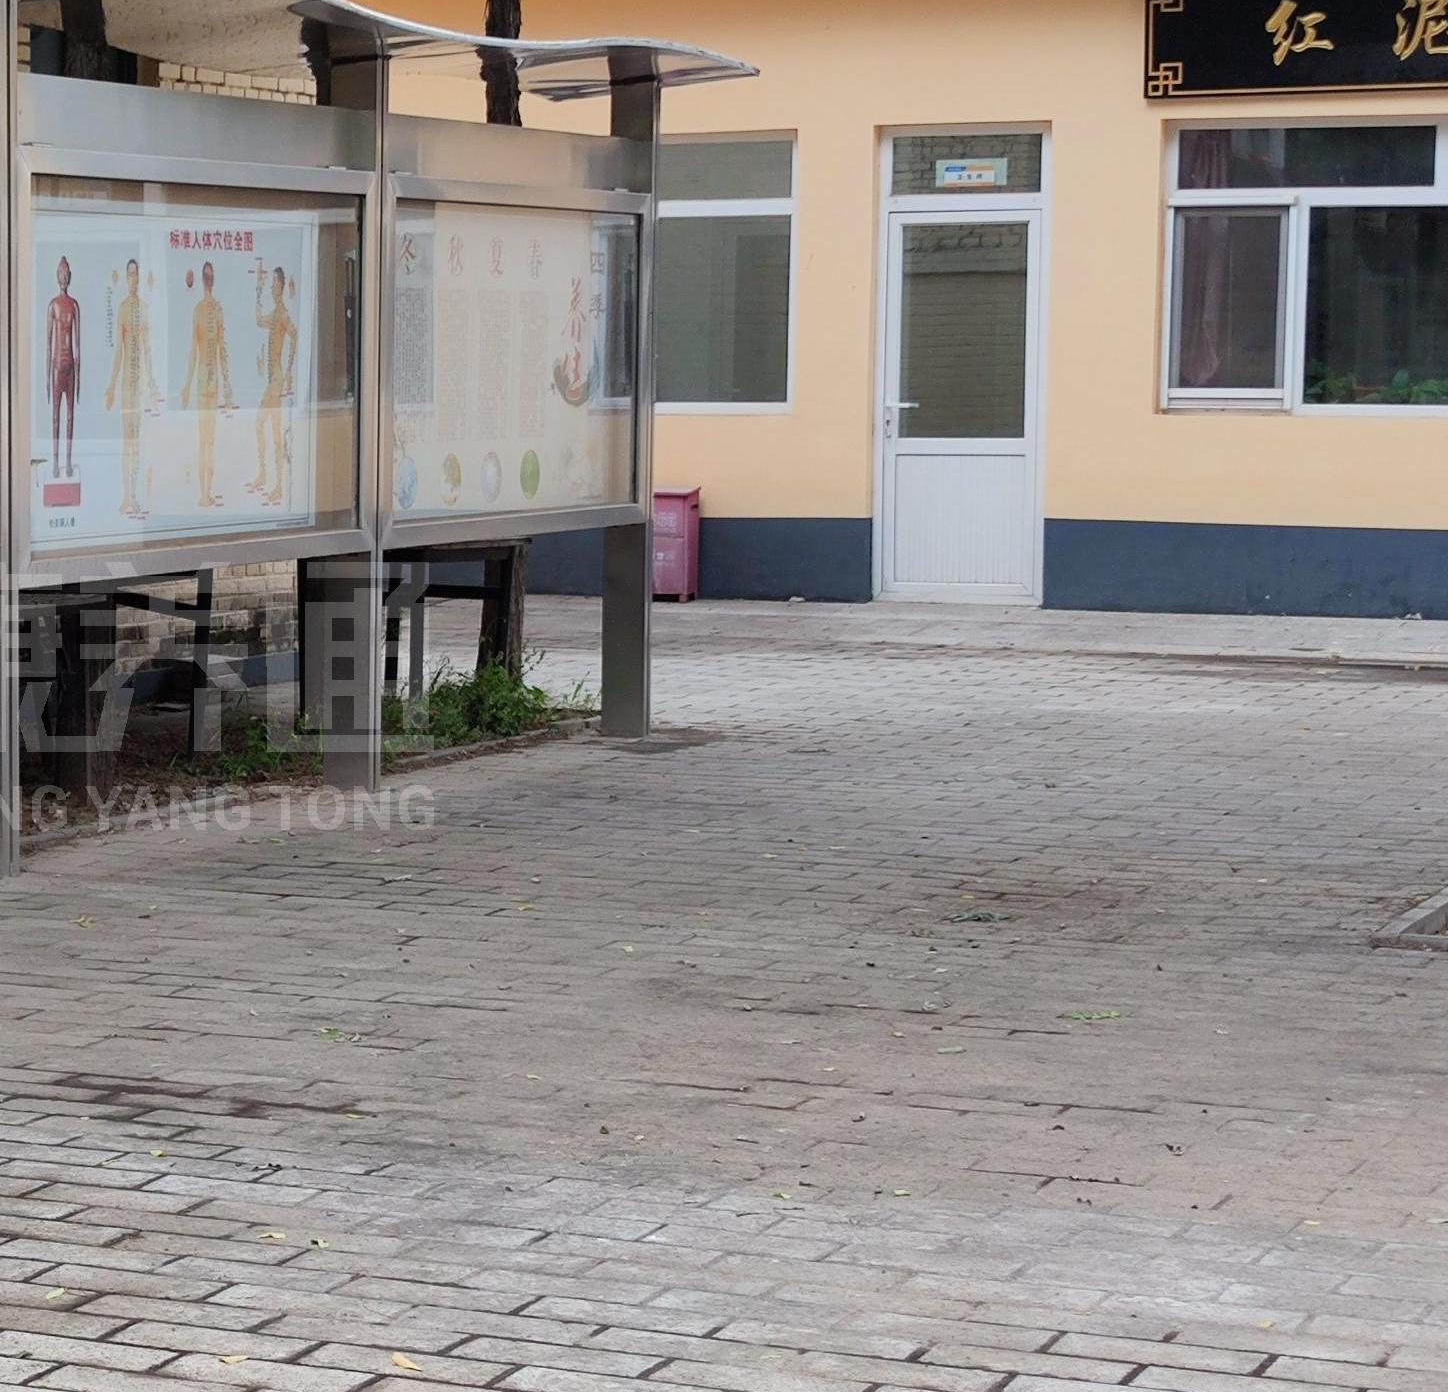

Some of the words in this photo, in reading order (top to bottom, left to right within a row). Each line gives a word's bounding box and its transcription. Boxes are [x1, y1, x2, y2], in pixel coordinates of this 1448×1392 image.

[169, 230, 254, 252] 标准人体穴位全图
[400, 233, 416, 276] 冬
